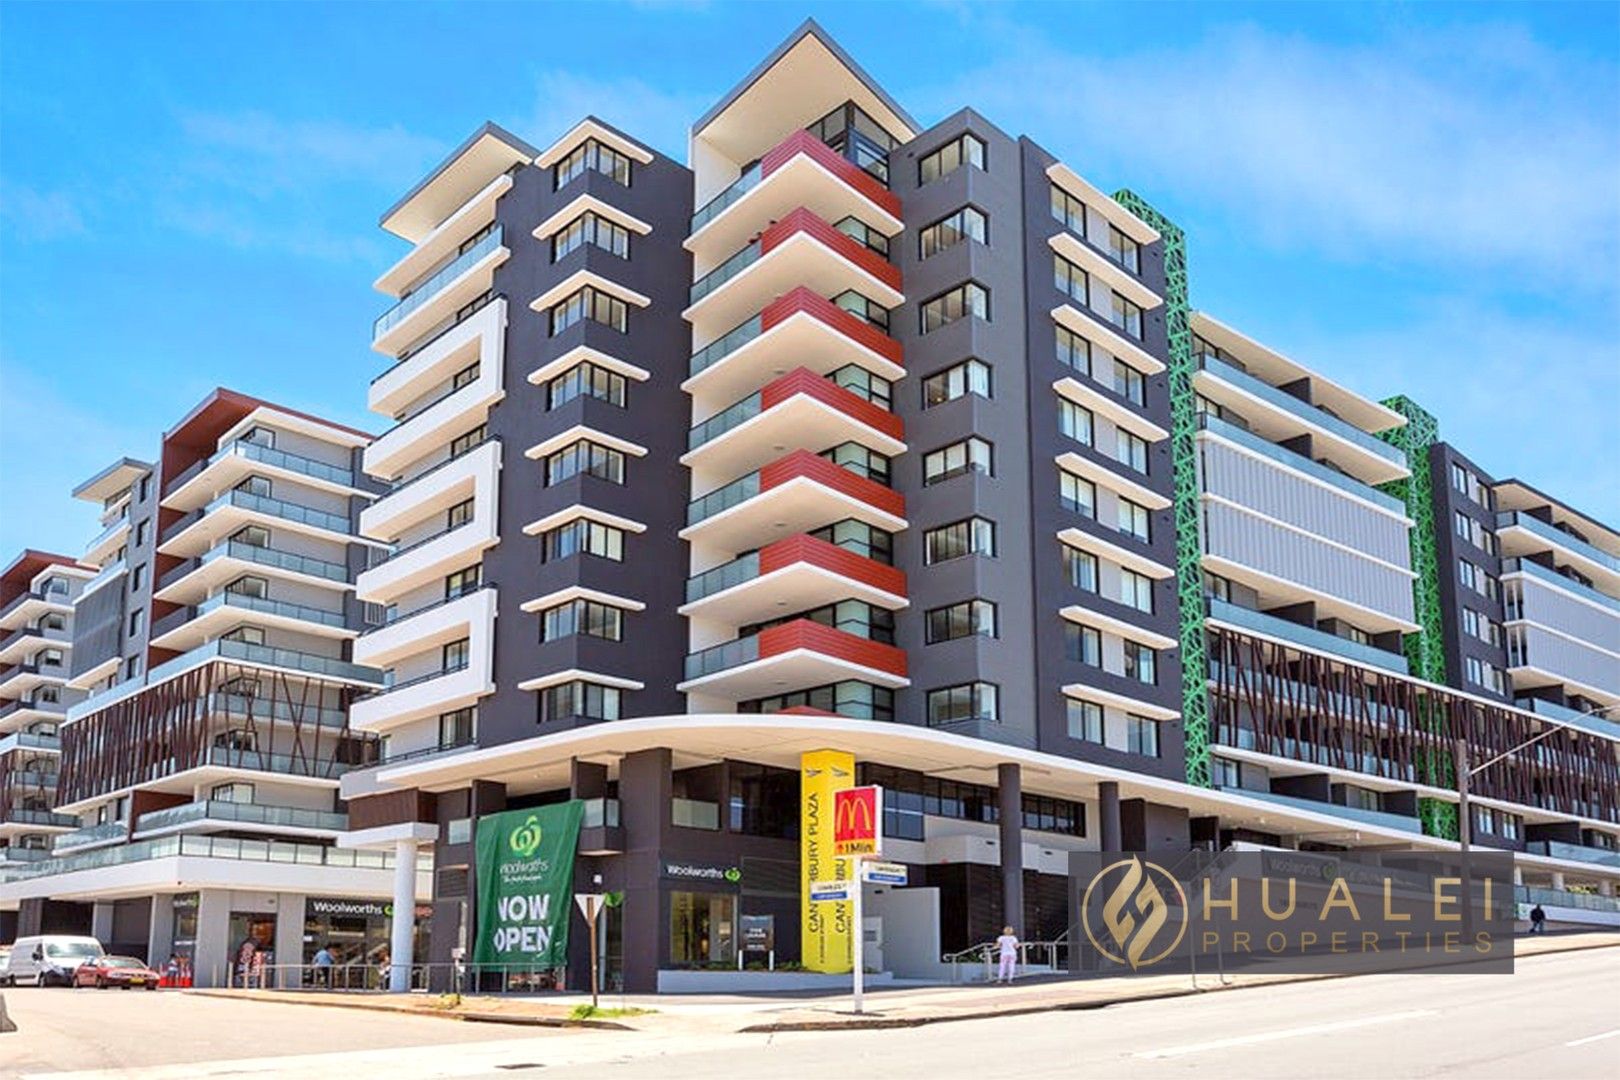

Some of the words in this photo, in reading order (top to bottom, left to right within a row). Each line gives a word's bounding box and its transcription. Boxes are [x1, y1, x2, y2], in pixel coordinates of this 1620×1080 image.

[807, 791, 819, 838] PLAZA
[666, 864, 723, 879] Woolworths
[808, 840, 819, 932] CANBURY
[313, 901, 383, 916] Woolworths
[498, 893, 550, 923] NOW
[493, 923, 553, 953] OPEN
